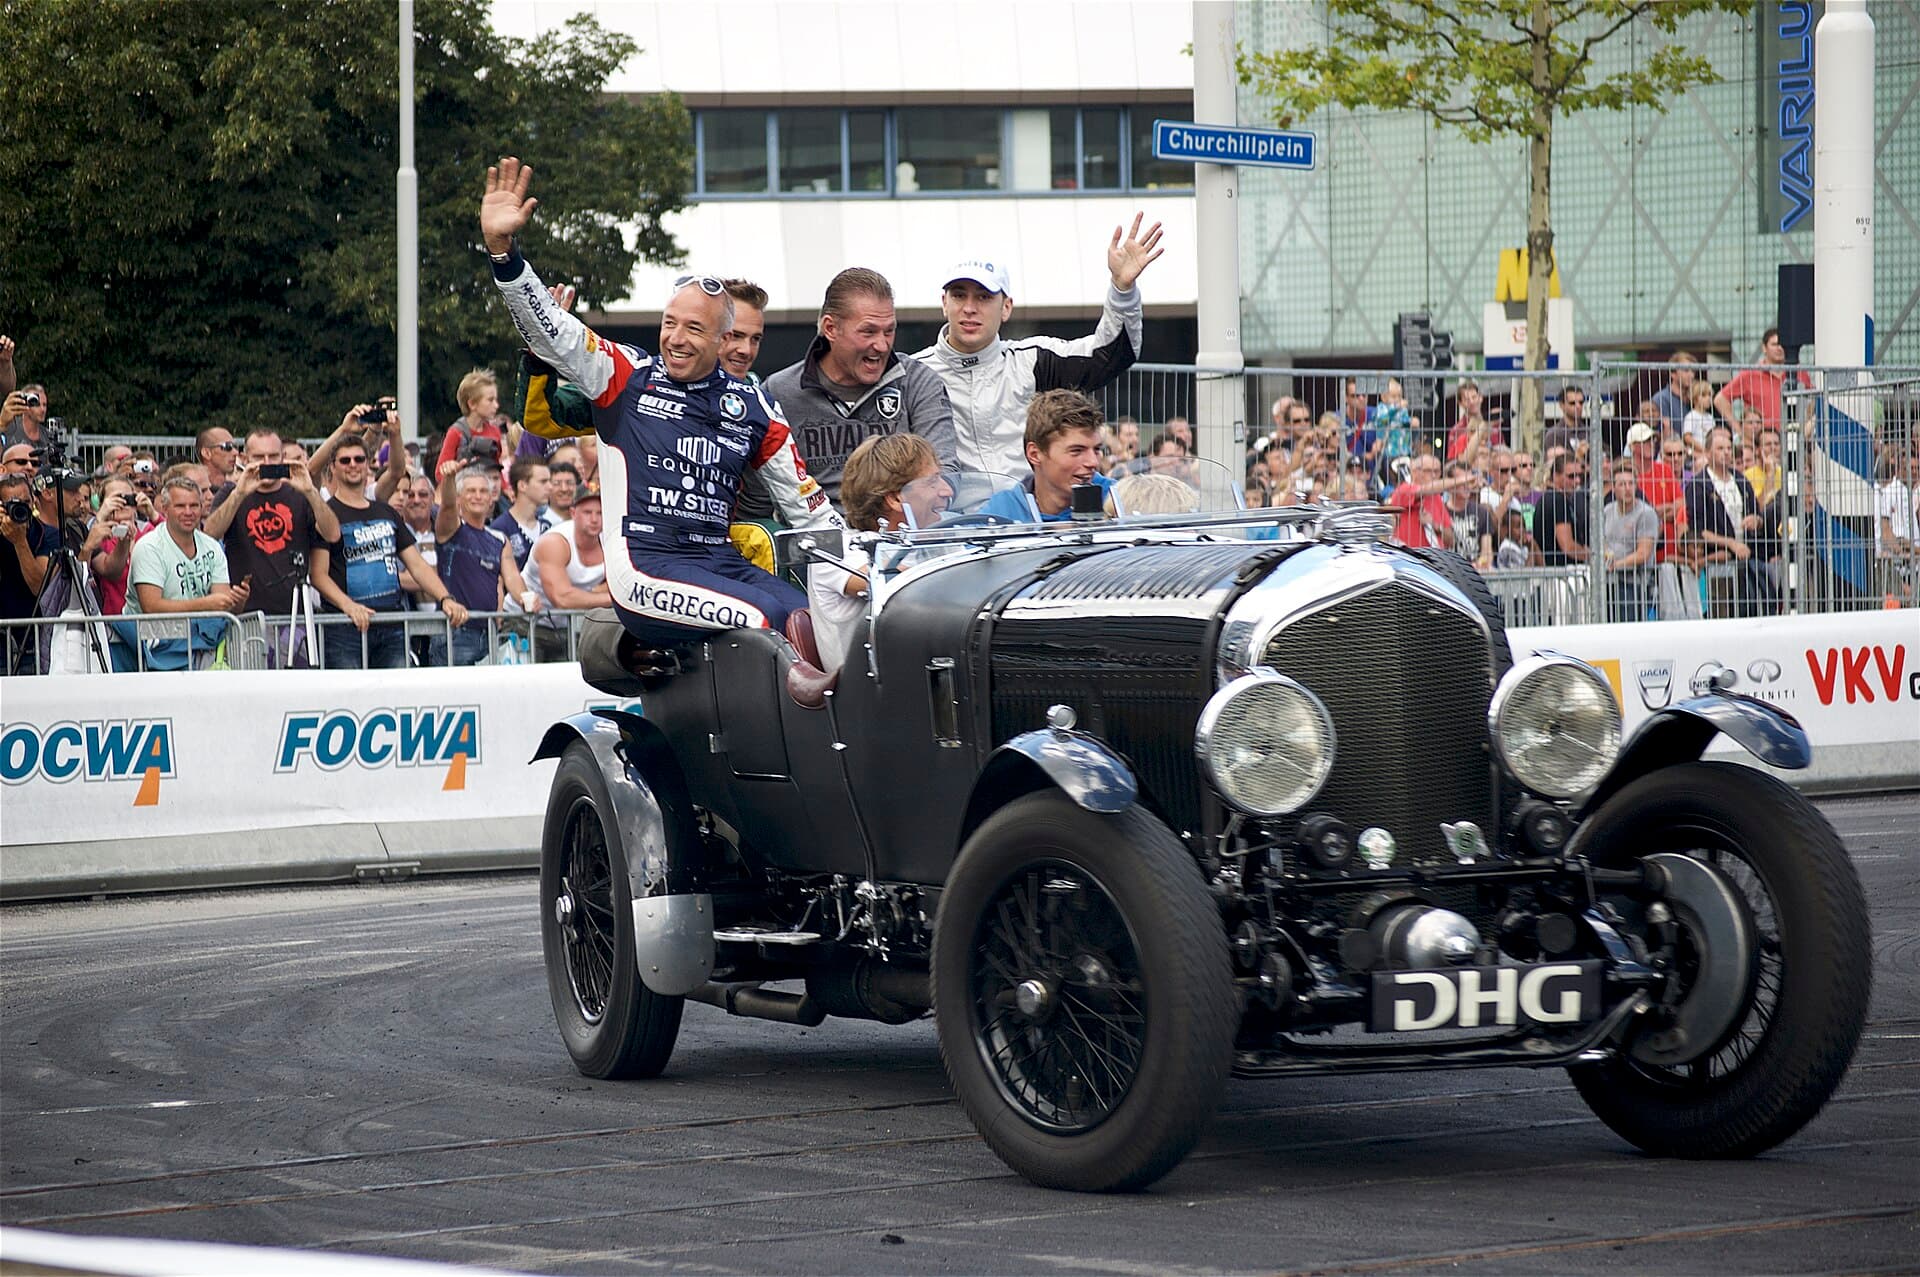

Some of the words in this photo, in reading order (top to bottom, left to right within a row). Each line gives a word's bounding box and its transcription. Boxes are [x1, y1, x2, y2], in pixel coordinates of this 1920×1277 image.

[1779, 0, 1815, 232] VARILU
[1168, 129, 1304, 159] Churchillplein
[1226, 188, 1233, 199] 3
[803, 422, 899, 458] RIVA
[648, 486, 681, 507] TW
[1640, 669, 1669, 677] DACIA
[1692, 680, 1712, 689] NIS
[1805, 644, 1905, 706] VKV
[1743, 689, 1796, 700] FINITI
[0, 718, 176, 786] OCWA
[276, 706, 481, 773] FOCWA
[1394, 965, 1583, 1031] DHG
